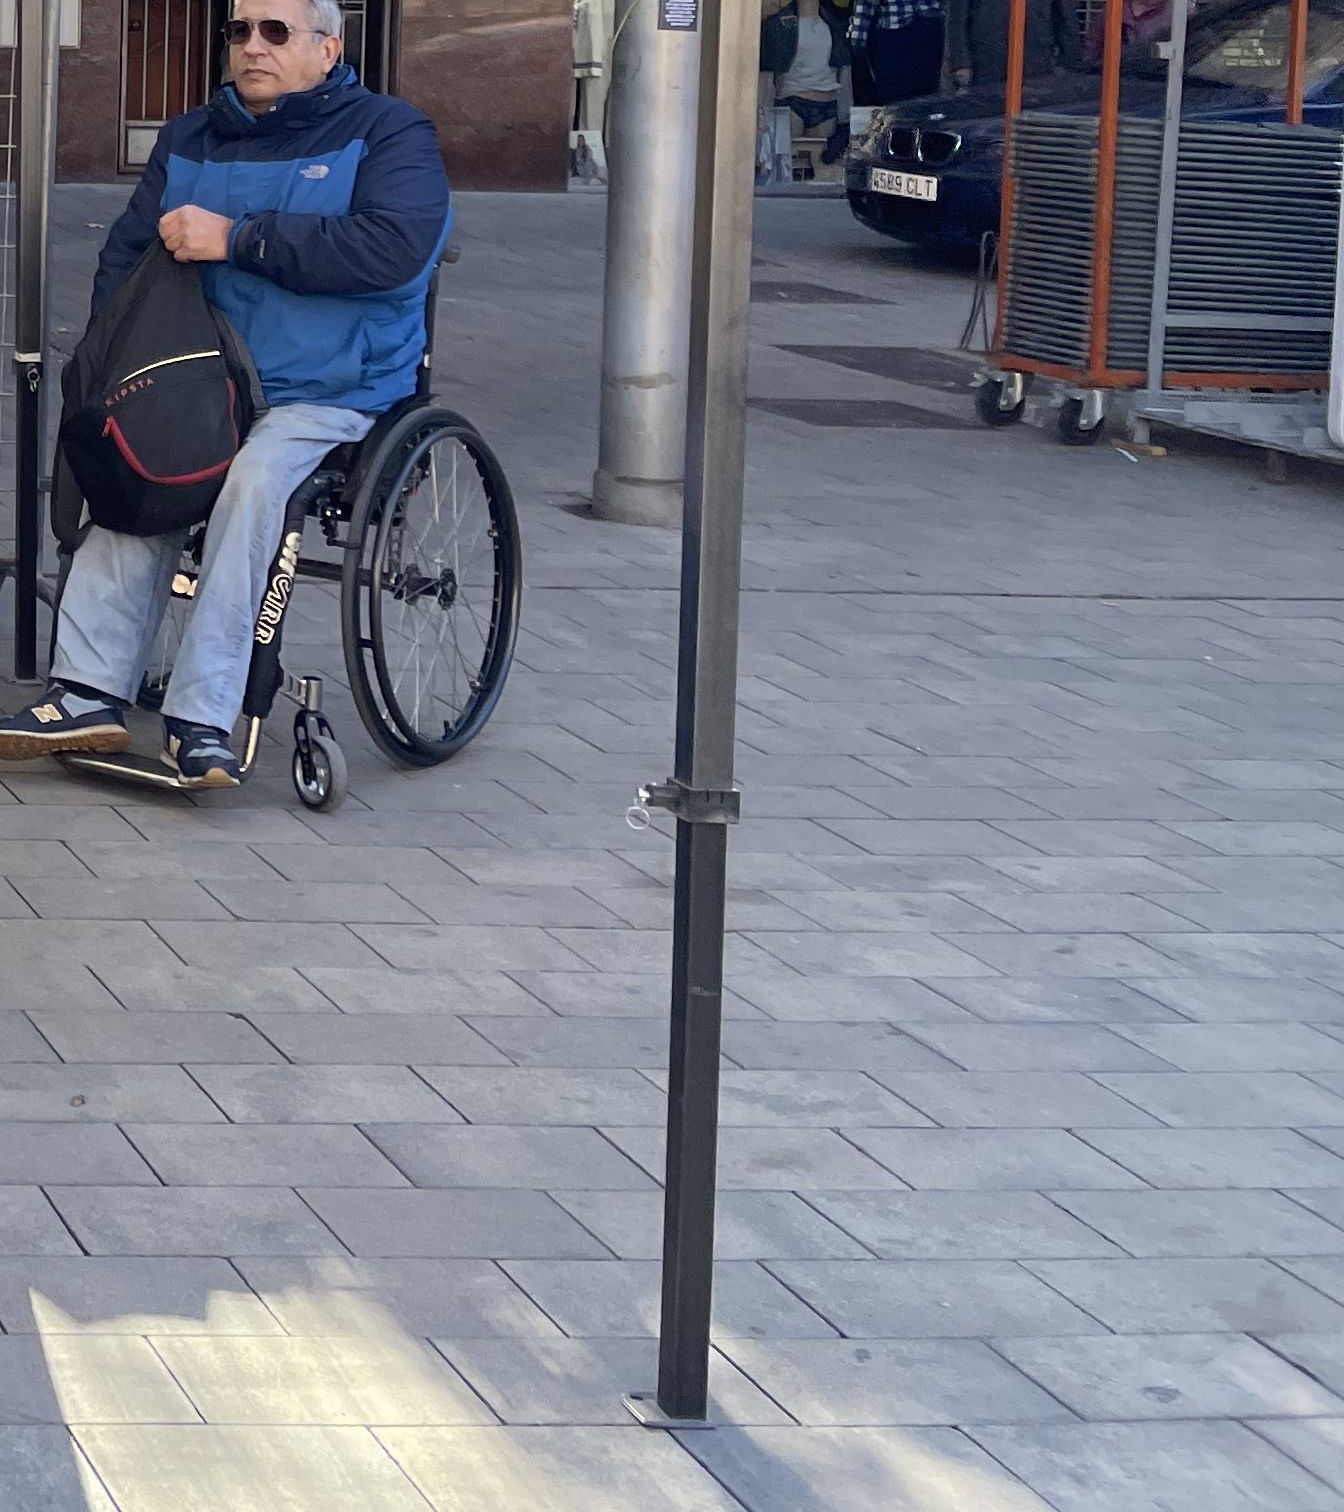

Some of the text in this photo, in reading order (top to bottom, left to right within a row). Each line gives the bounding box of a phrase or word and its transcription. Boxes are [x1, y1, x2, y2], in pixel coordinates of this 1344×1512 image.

[906, 177, 933, 198] CLT
[105, 377, 154, 408] KIPSTA
[31, 703, 63, 724] N
